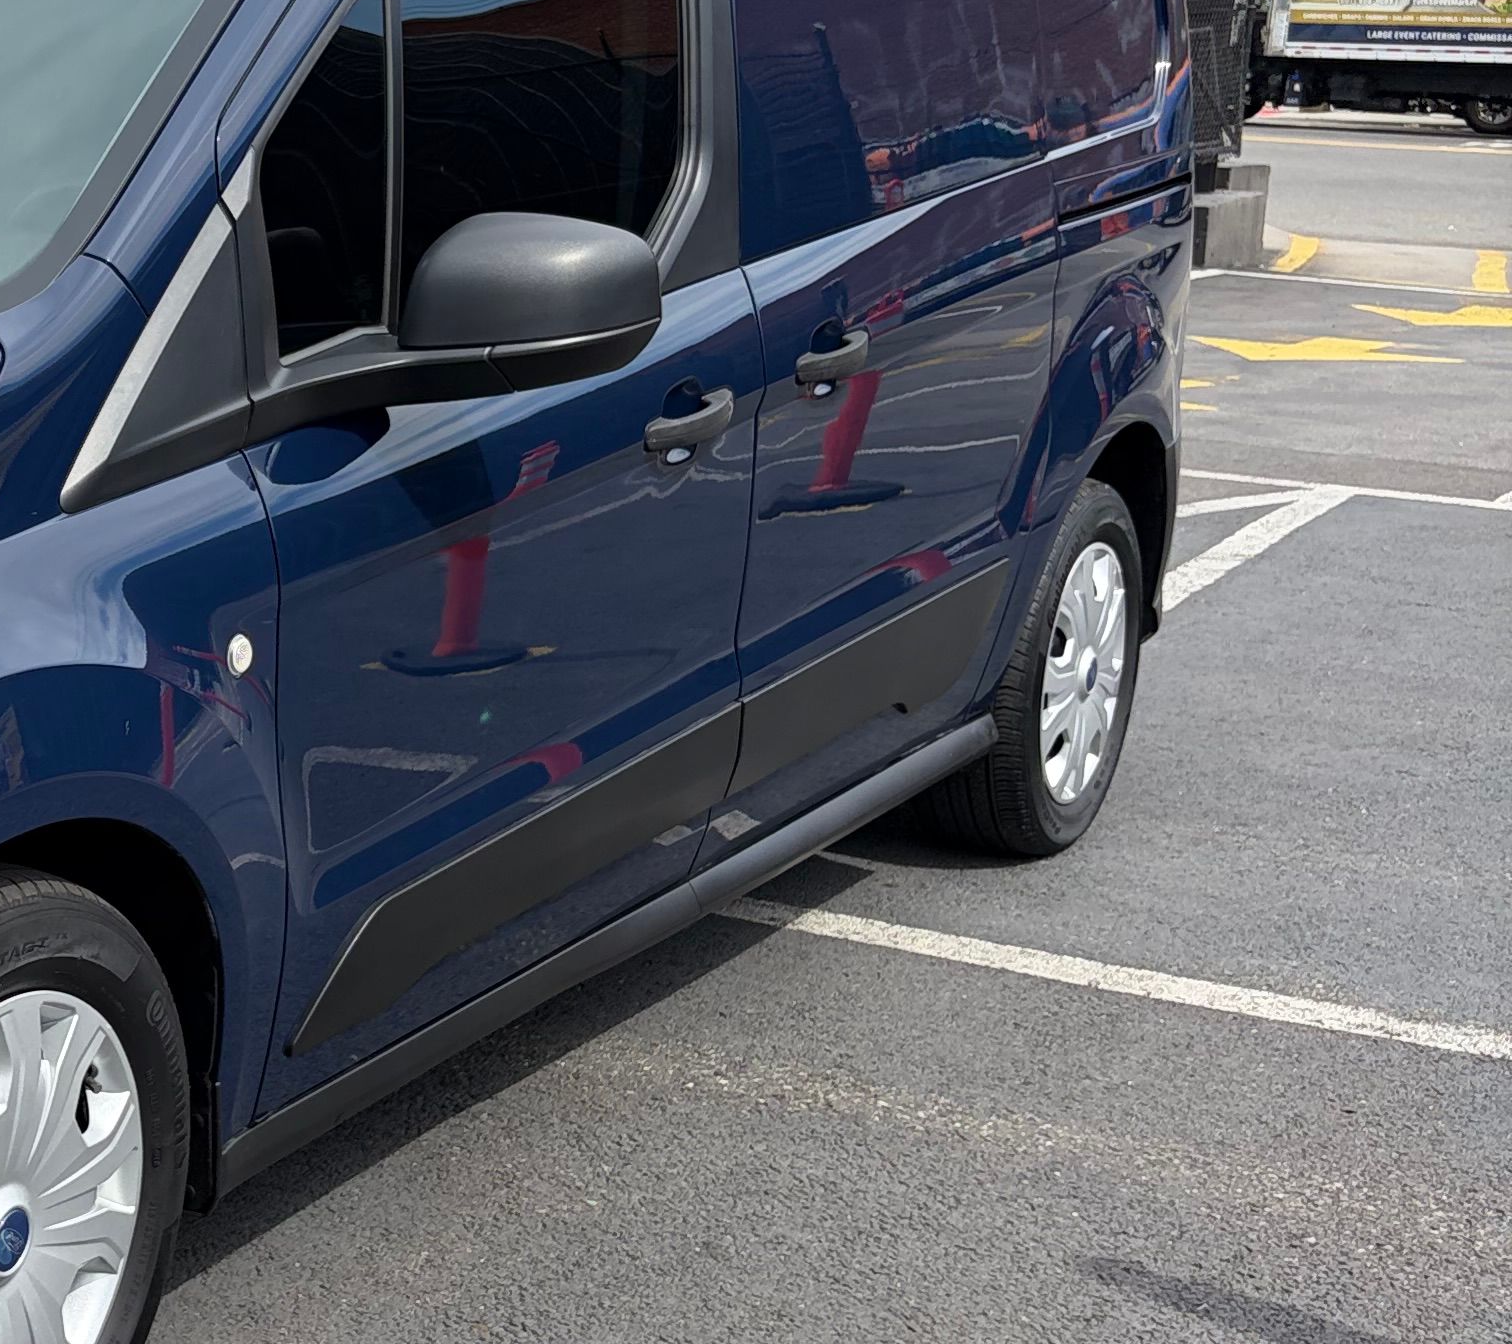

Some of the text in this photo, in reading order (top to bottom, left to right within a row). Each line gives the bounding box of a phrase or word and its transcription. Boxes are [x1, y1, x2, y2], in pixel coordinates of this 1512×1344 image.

[1366, 30, 1393, 39] LARGE
[1393, 31, 1421, 40] EVENT
[1421, 31, 1462, 41] CATERING
